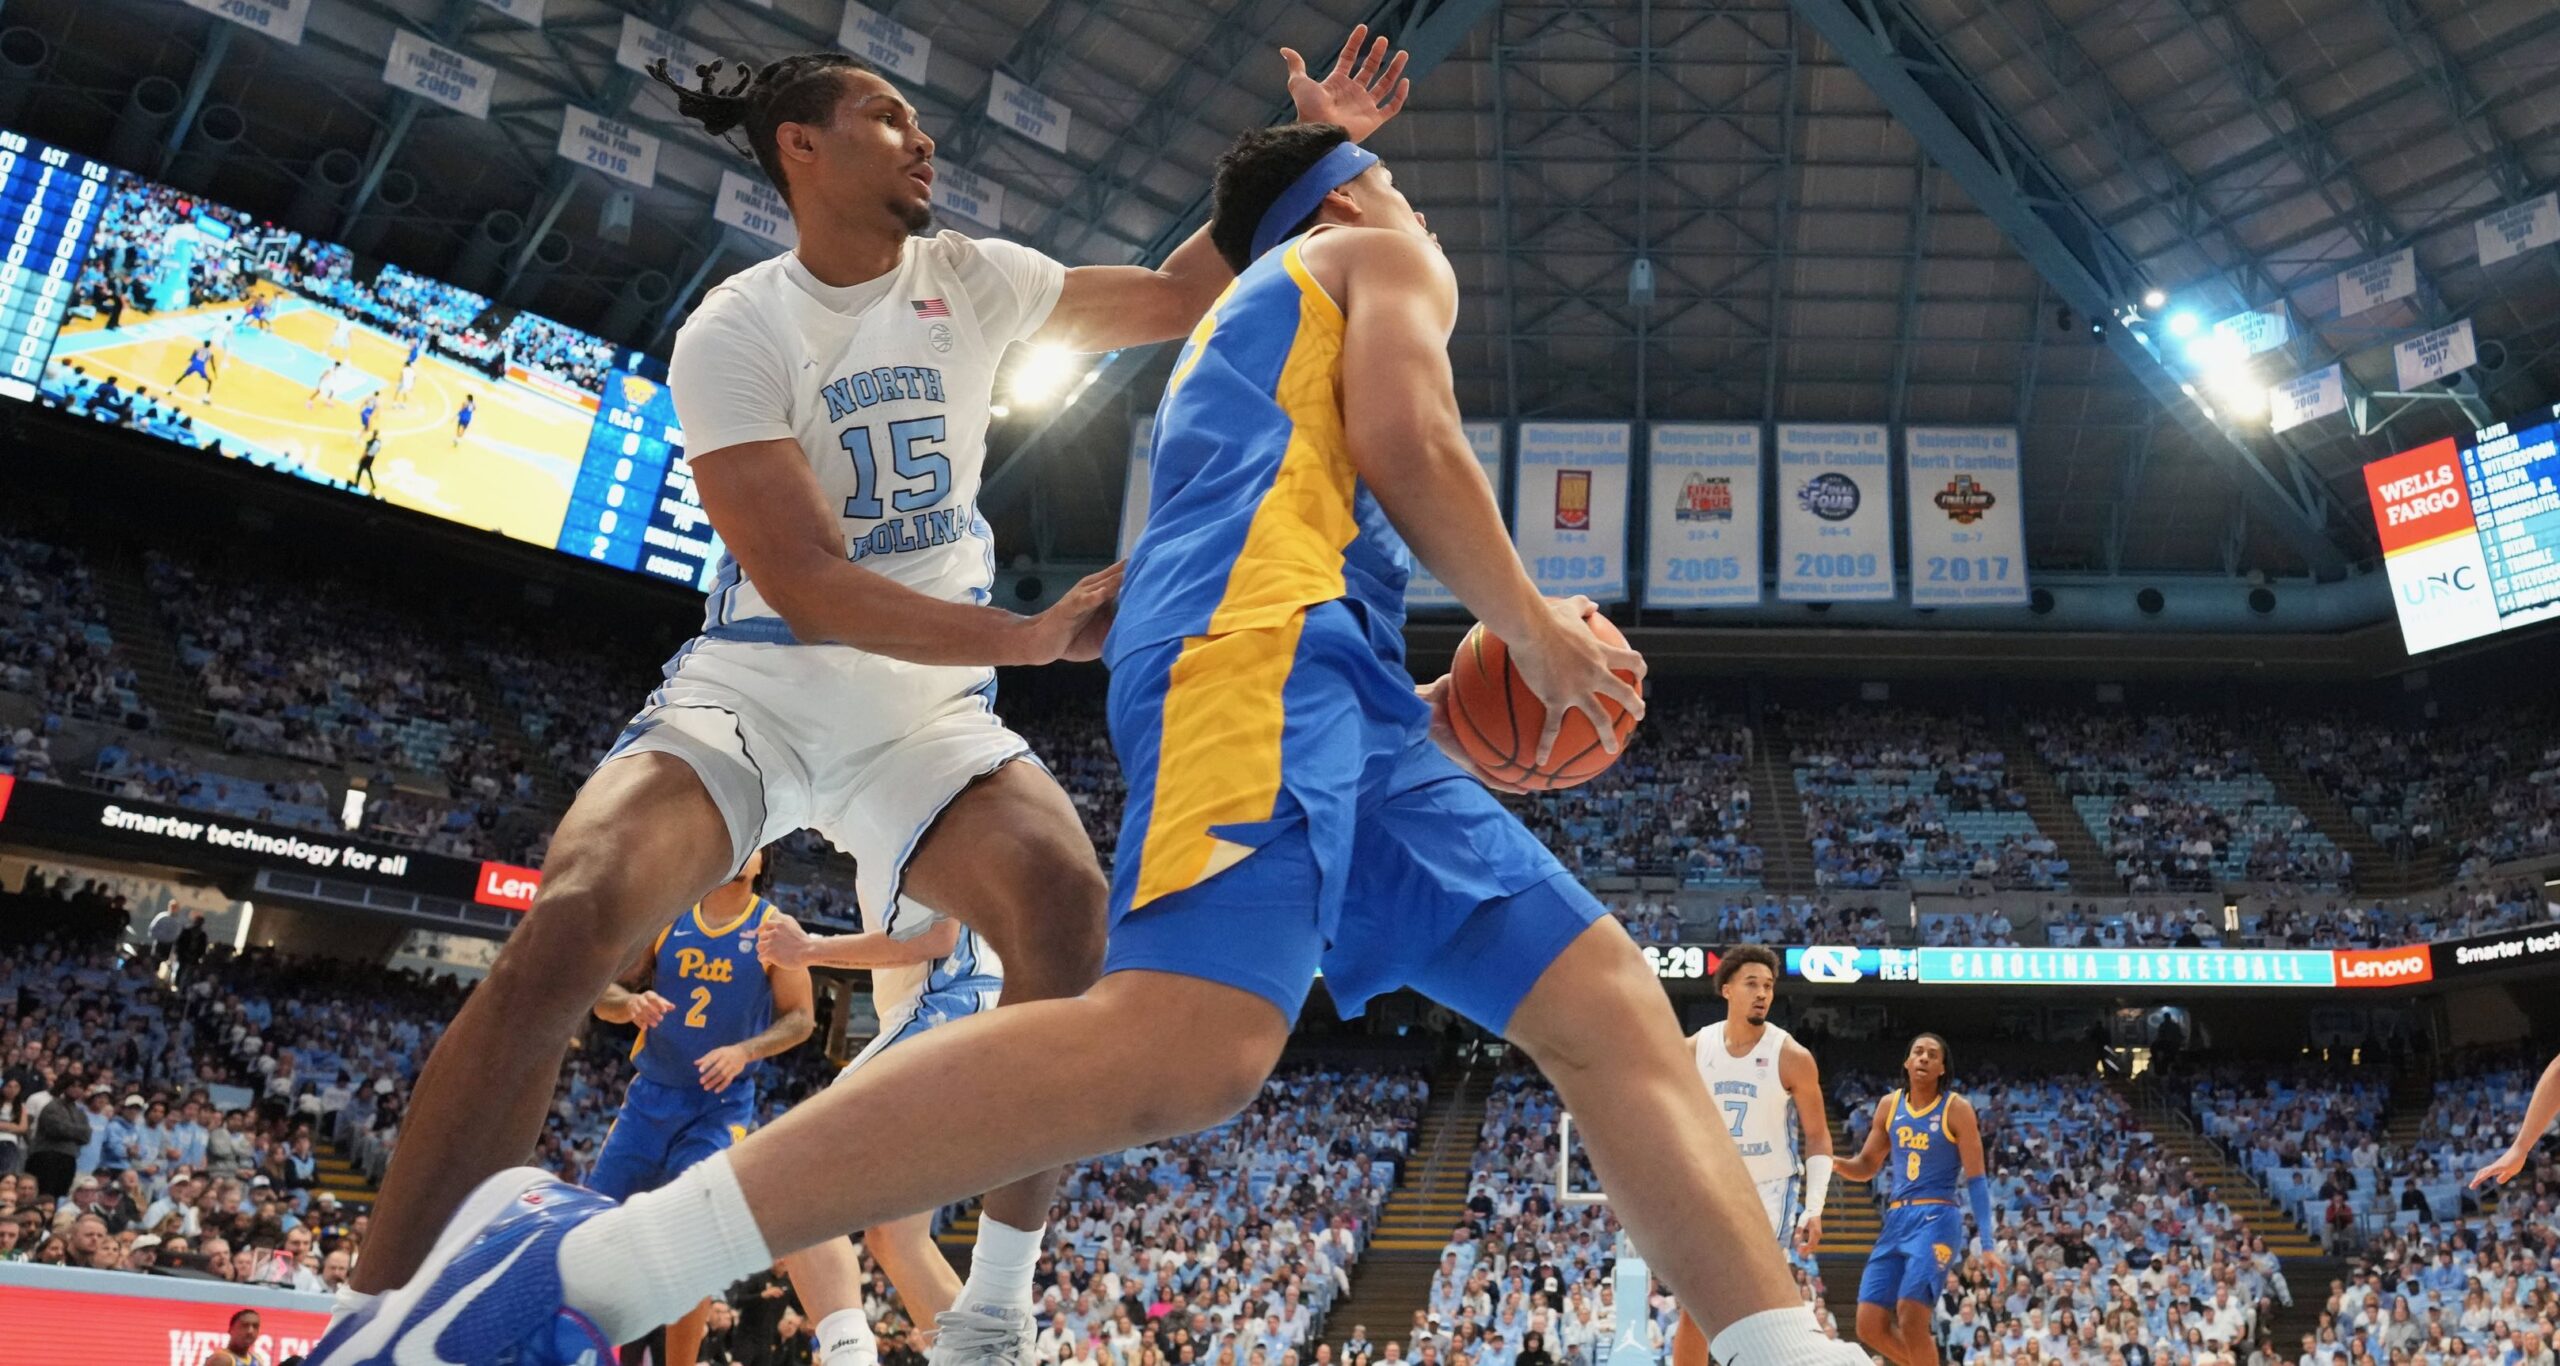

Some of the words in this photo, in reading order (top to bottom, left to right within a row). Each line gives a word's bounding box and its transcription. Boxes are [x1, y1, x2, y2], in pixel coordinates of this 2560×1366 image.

[415, 72, 462, 101] 2009
[40, 146, 69, 168] AST
[82, 161, 109, 182] FLS
[586, 145, 628, 174] 2016
[742, 211, 777, 236] 2017
[2422, 349, 2448, 369] 2017
[821, 366, 945, 423] NORTH
[2294, 392, 2321, 410] 2009
[1608, 429, 1622, 443] of
[1737, 431, 1751, 445] of
[1787, 431, 1860, 446] University
[1864, 431, 1878, 445] of
[1916, 434, 1990, 449] University
[1994, 434, 2008, 448] of
[840, 415, 951, 519] 15
[1780, 450, 1820, 465] North
[1824, 451, 1886, 466] Carolina
[1911, 454, 1951, 469] North
[1954, 455, 2017, 470] Carolina
[1686, 484, 1730, 499] FINAL
[2378, 465, 2454, 503] WELLS
[1691, 497, 1732, 511] FOUR
[2386, 487, 2460, 527] FARGO
[850, 505, 968, 562] ROLINA
[590, 535, 610, 560] 2
[1535, 555, 1606, 580] 1993
[1667, 556, 1740, 581] 2005
[1794, 552, 1877, 579] 2009
[1927, 556, 2009, 582] 2017
[2402, 566, 2475, 606] UNC
[101, 805, 204, 840] Smarter
[207, 823, 339, 868] technology
[342, 846, 378, 870] for
[378, 855, 407, 876] all
[487, 871, 538, 902] Len
[675, 947, 733, 983] Pitt
[2456, 940, 2525, 965] Smarter
[1950, 953, 2098, 979] CAROLINA
[2119, 954, 2304, 982] BASKETBALL
[2340, 956, 2424, 979] Lenovo
[684, 986, 712, 1029] 2
[1714, 1080, 1758, 1098] NORTH
[1724, 1101, 1749, 1137] 7
[1737, 1141, 1772, 1156] LINA
[1896, 1125, 1930, 1151] Pitt
[1906, 1151, 1922, 1182] 8
